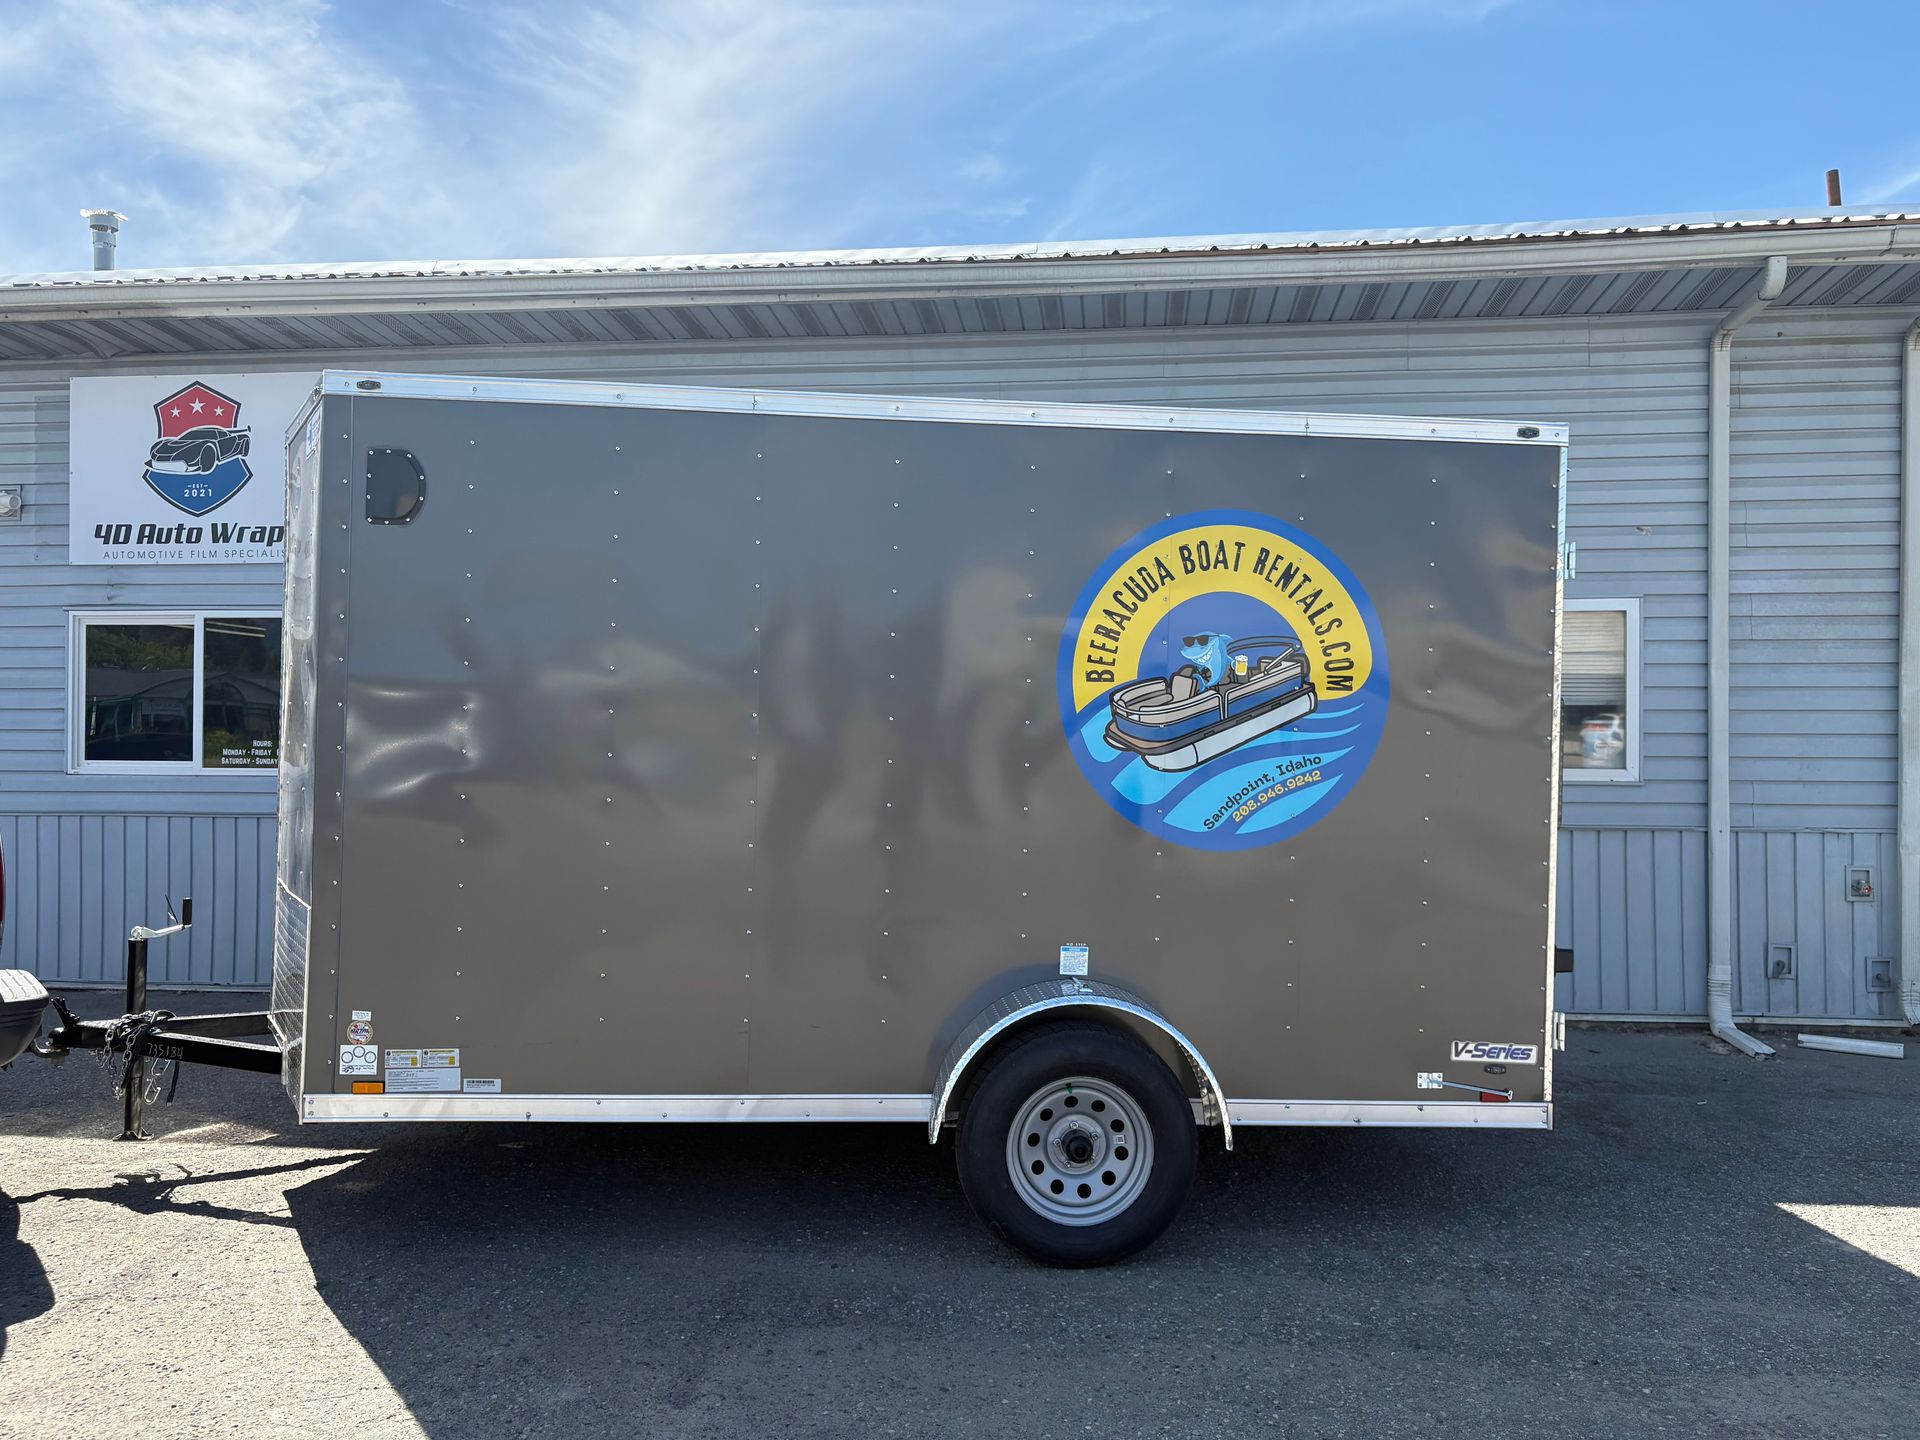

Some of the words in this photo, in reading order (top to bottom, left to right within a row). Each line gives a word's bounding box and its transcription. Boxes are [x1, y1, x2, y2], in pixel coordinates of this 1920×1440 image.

[184, 488, 213, 497] 2021
[94, 523, 133, 545] 4D
[136, 522, 204, 545] Auto
[211, 522, 285, 547] Wrap
[103, 550, 184, 559] AUTOMOTIVE
[190, 550, 218, 559] FILM
[1086, 556, 1176, 683] BEERACUDA
[1178, 539, 1246, 576] BOAT
[1252, 546, 1355, 692] RENTALS.COM
[222, 748, 246, 756] MONDAY
[251, 748, 271, 756] FRIDAY
[1203, 772, 1276, 831] Sandpoint,
[1275, 755, 1322, 777] Idaho
[1232, 769, 1322, 823] 208.946.9242
[147, 1042, 184, 1060] 735184
[1454, 1041, 1533, 1060] V-Series
